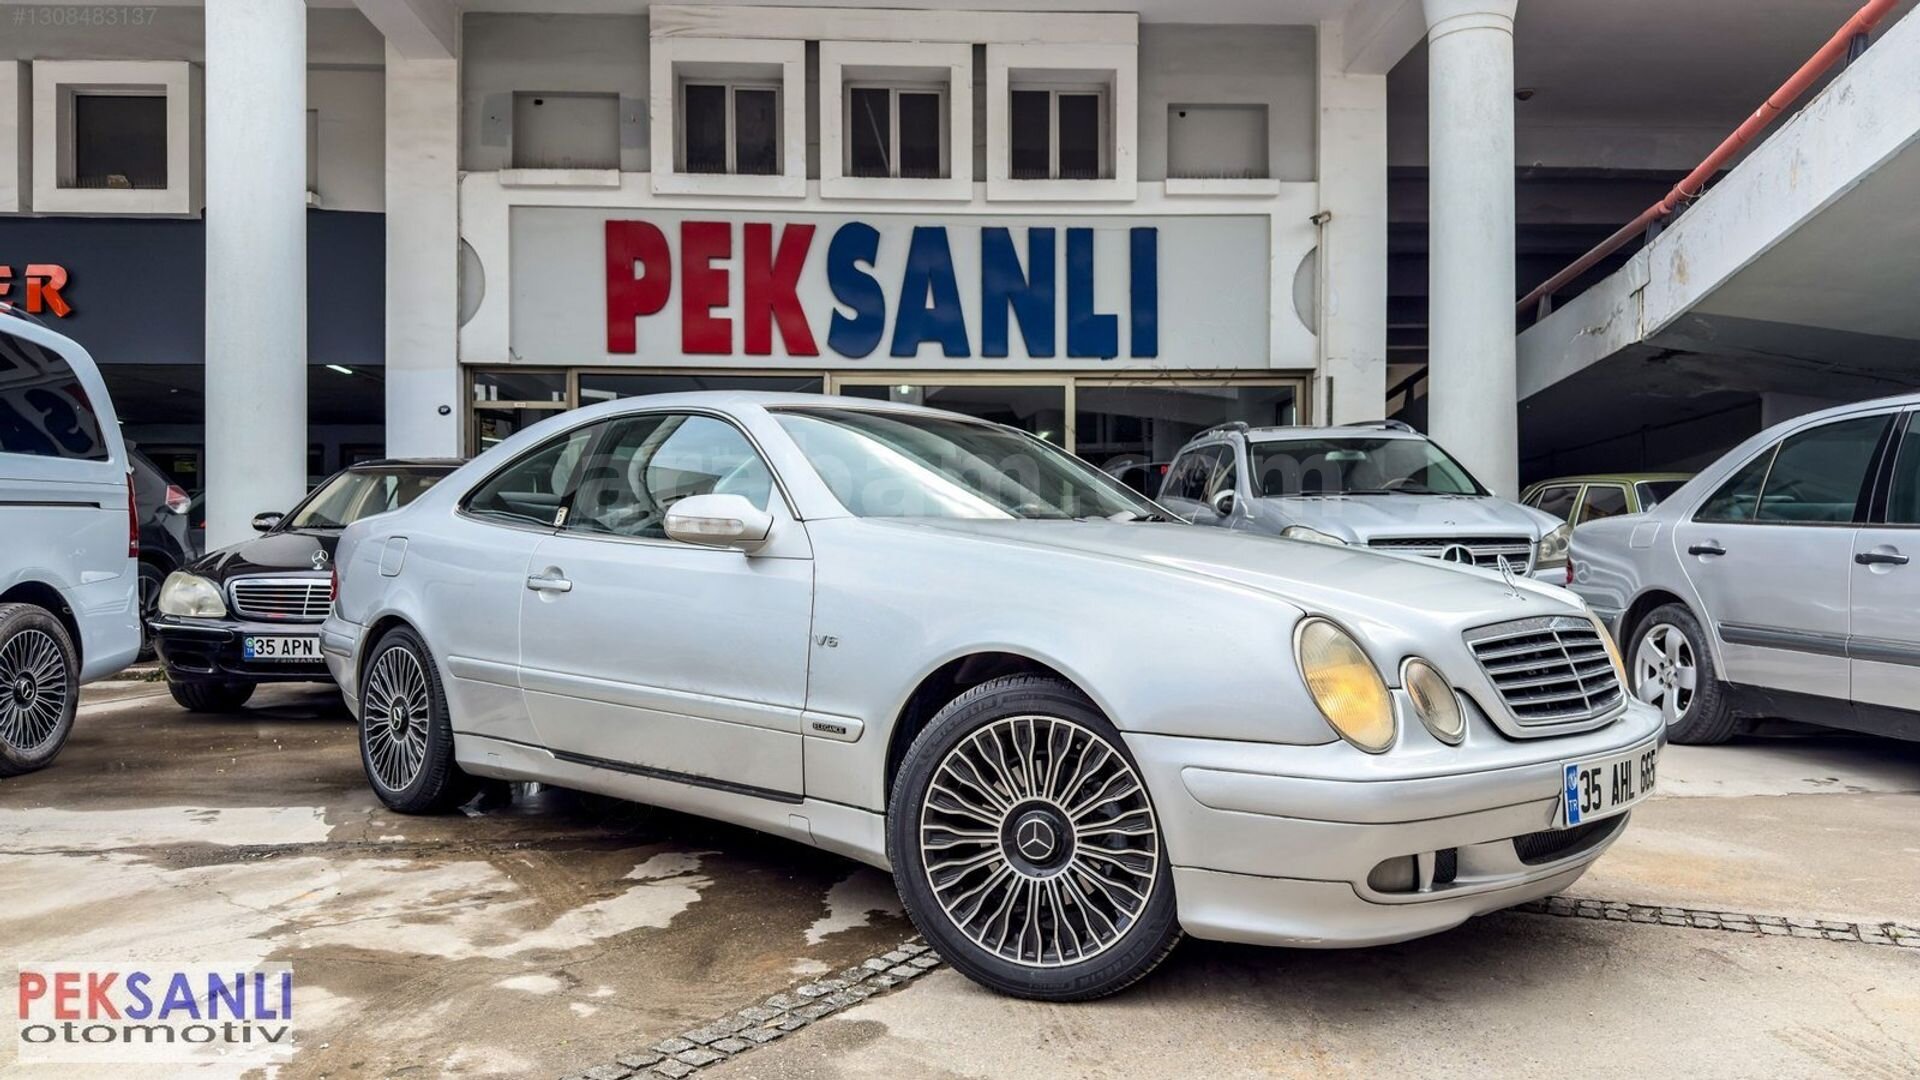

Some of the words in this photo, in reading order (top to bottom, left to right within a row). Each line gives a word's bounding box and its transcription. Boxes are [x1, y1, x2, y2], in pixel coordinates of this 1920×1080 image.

[604, 219, 1158, 359] PEKSANLI
[255, 639, 275, 655] 35
[281, 639, 313, 655] APN
[814, 634, 839, 648] V6
[1579, 767, 1602, 814] 35
[1611, 759, 1635, 806] AHL
[1568, 799, 1578, 811] TR
